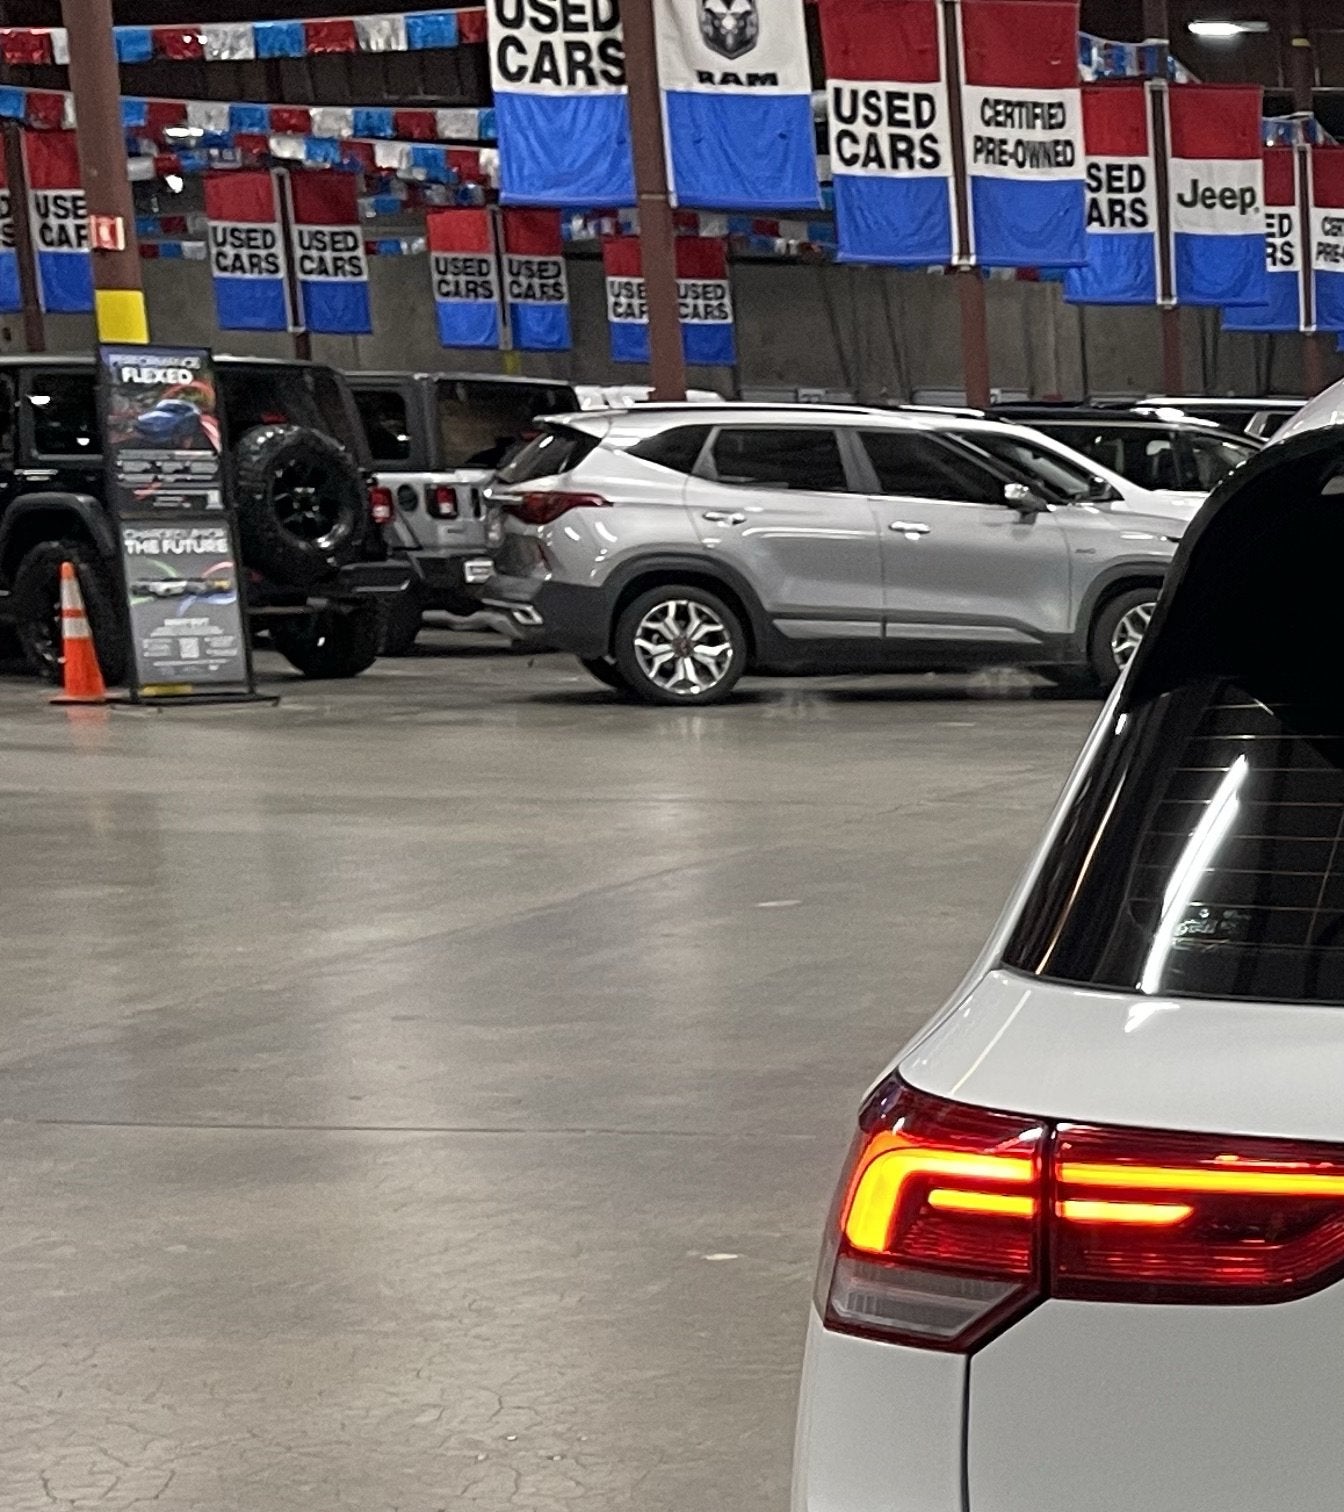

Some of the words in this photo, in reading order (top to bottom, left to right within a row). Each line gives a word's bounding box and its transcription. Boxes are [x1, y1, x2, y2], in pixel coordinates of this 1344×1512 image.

[495, 0, 621, 33] USED
[496, 35, 626, 86] CARS
[696, 70, 779, 87] RAM
[833, 87, 937, 130] USED
[980, 97, 1066, 130] CERTIFIED
[835, 129, 941, 169] CARS
[973, 135, 1076, 168] PRE-OWNED
[1085, 162, 1146, 195] SED
[35, 193, 88, 219] USE
[1176, 179, 1257, 215] Jeep
[1086, 197, 1149, 228] ARS
[211, 225, 276, 249] USED
[299, 229, 359, 252] USED
[215, 251, 280, 275] CARS
[300, 254, 363, 276] CARS
[434, 257, 491, 276] USED
[507, 259, 562, 279] USED
[437, 279, 494, 299] CARS
[509, 280, 565, 301] CARS
[609, 280, 648, 299] USE
[677, 282, 726, 300] USED
[679, 302, 729, 320] CARS
[121, 366, 194, 385] FLEXED
[123, 539, 161, 555] THE
[161, 538, 229, 555] FUTURE
